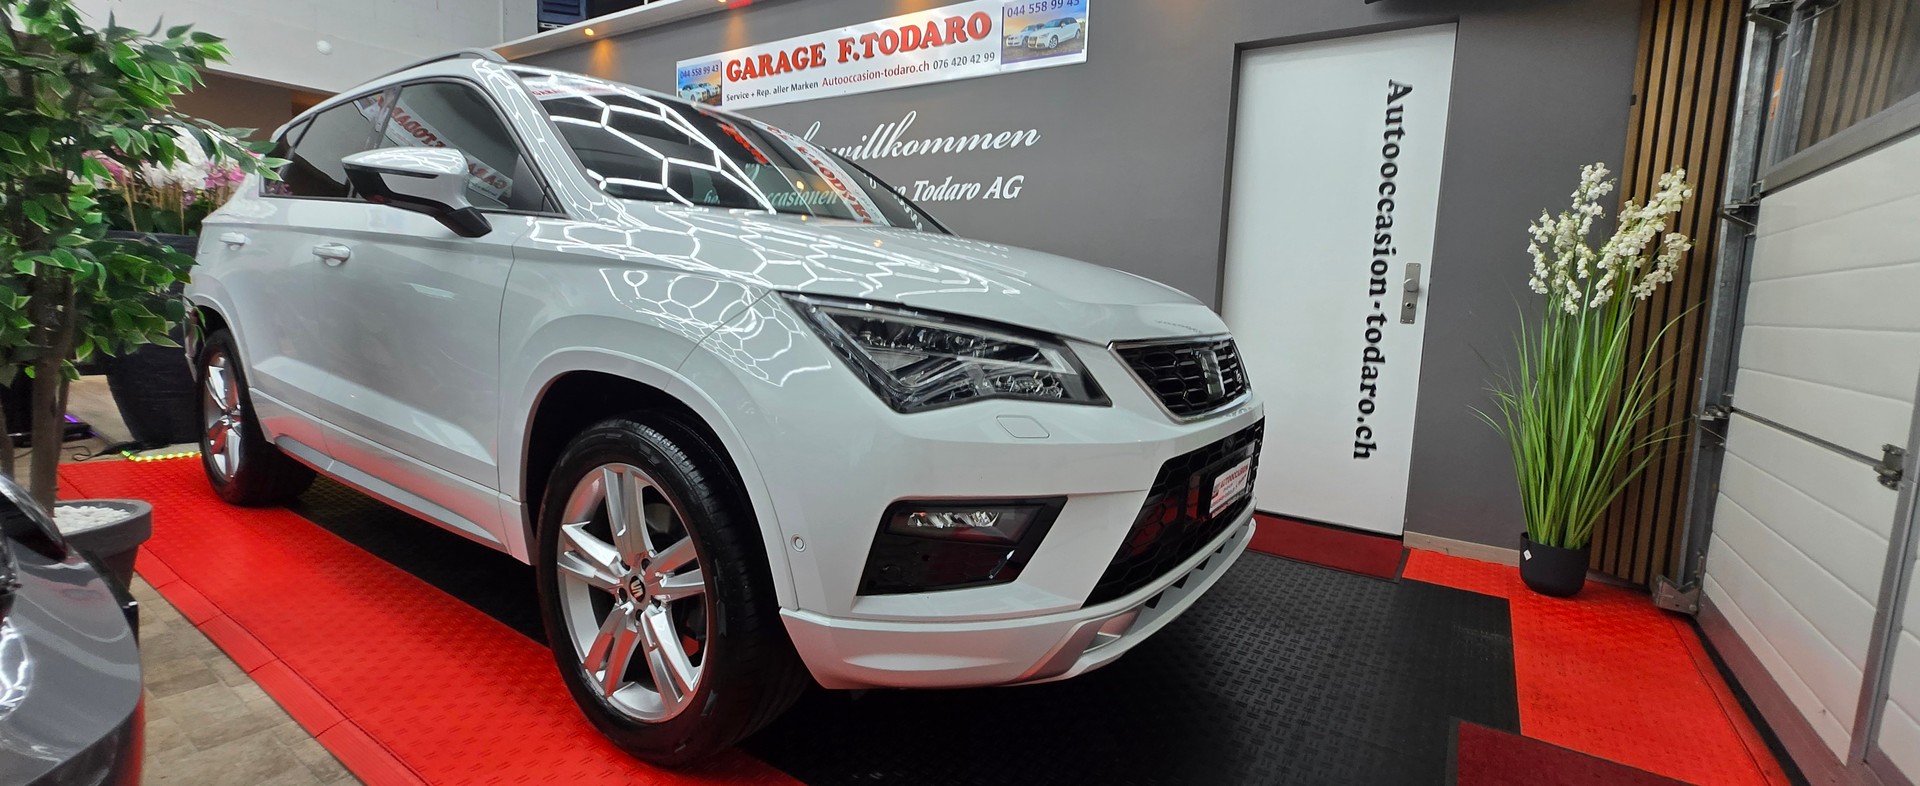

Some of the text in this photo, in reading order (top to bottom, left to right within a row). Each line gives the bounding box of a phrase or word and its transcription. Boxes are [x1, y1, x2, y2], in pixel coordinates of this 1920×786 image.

[1007, 5, 1025, 17] 044
[1029, 1, 1047, 14] 558
[1051, 0, 1063, 9] 99
[726, 11, 992, 82] GARAGE F.TODARO
[680, 64, 719, 79] 044 558 99 43
[726, 91, 749, 102] Service
[756, 88, 771, 98] Rep.
[773, 84, 789, 94] aller
[791, 81, 819, 92] Marken
[822, 61, 930, 87] Autooccasion-todaro.ch
[933, 58, 948, 70] 076
[951, 55, 967, 67] 420
[970, 53, 981, 64] 42
[983, 52, 995, 62] 99
[912, 176, 980, 202] Todaro
[983, 174, 1026, 200] AG
[1353, 79, 1413, 461] Autooccasion-todaro.ch
